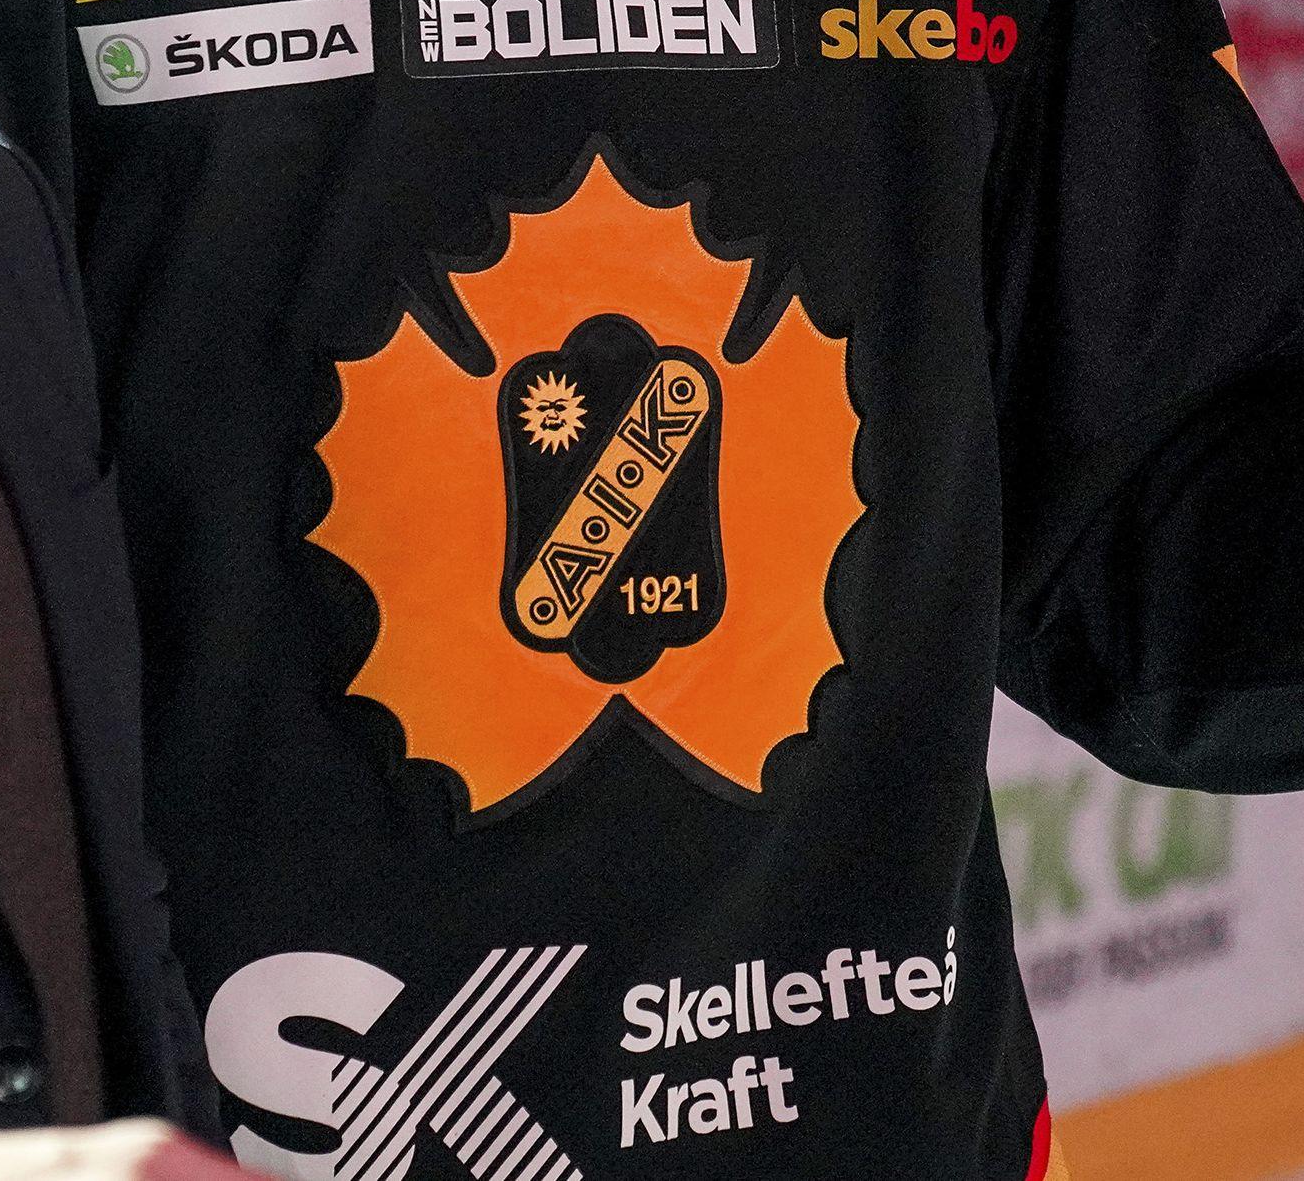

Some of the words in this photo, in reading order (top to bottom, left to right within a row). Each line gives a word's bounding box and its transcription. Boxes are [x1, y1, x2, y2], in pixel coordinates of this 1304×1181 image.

[164, 23, 360, 78] ŠKODA
[619, 573, 699, 616] 1921
[619, 925, 958, 1054] Skellefteå
[620, 1055, 799, 1149] Kraft
